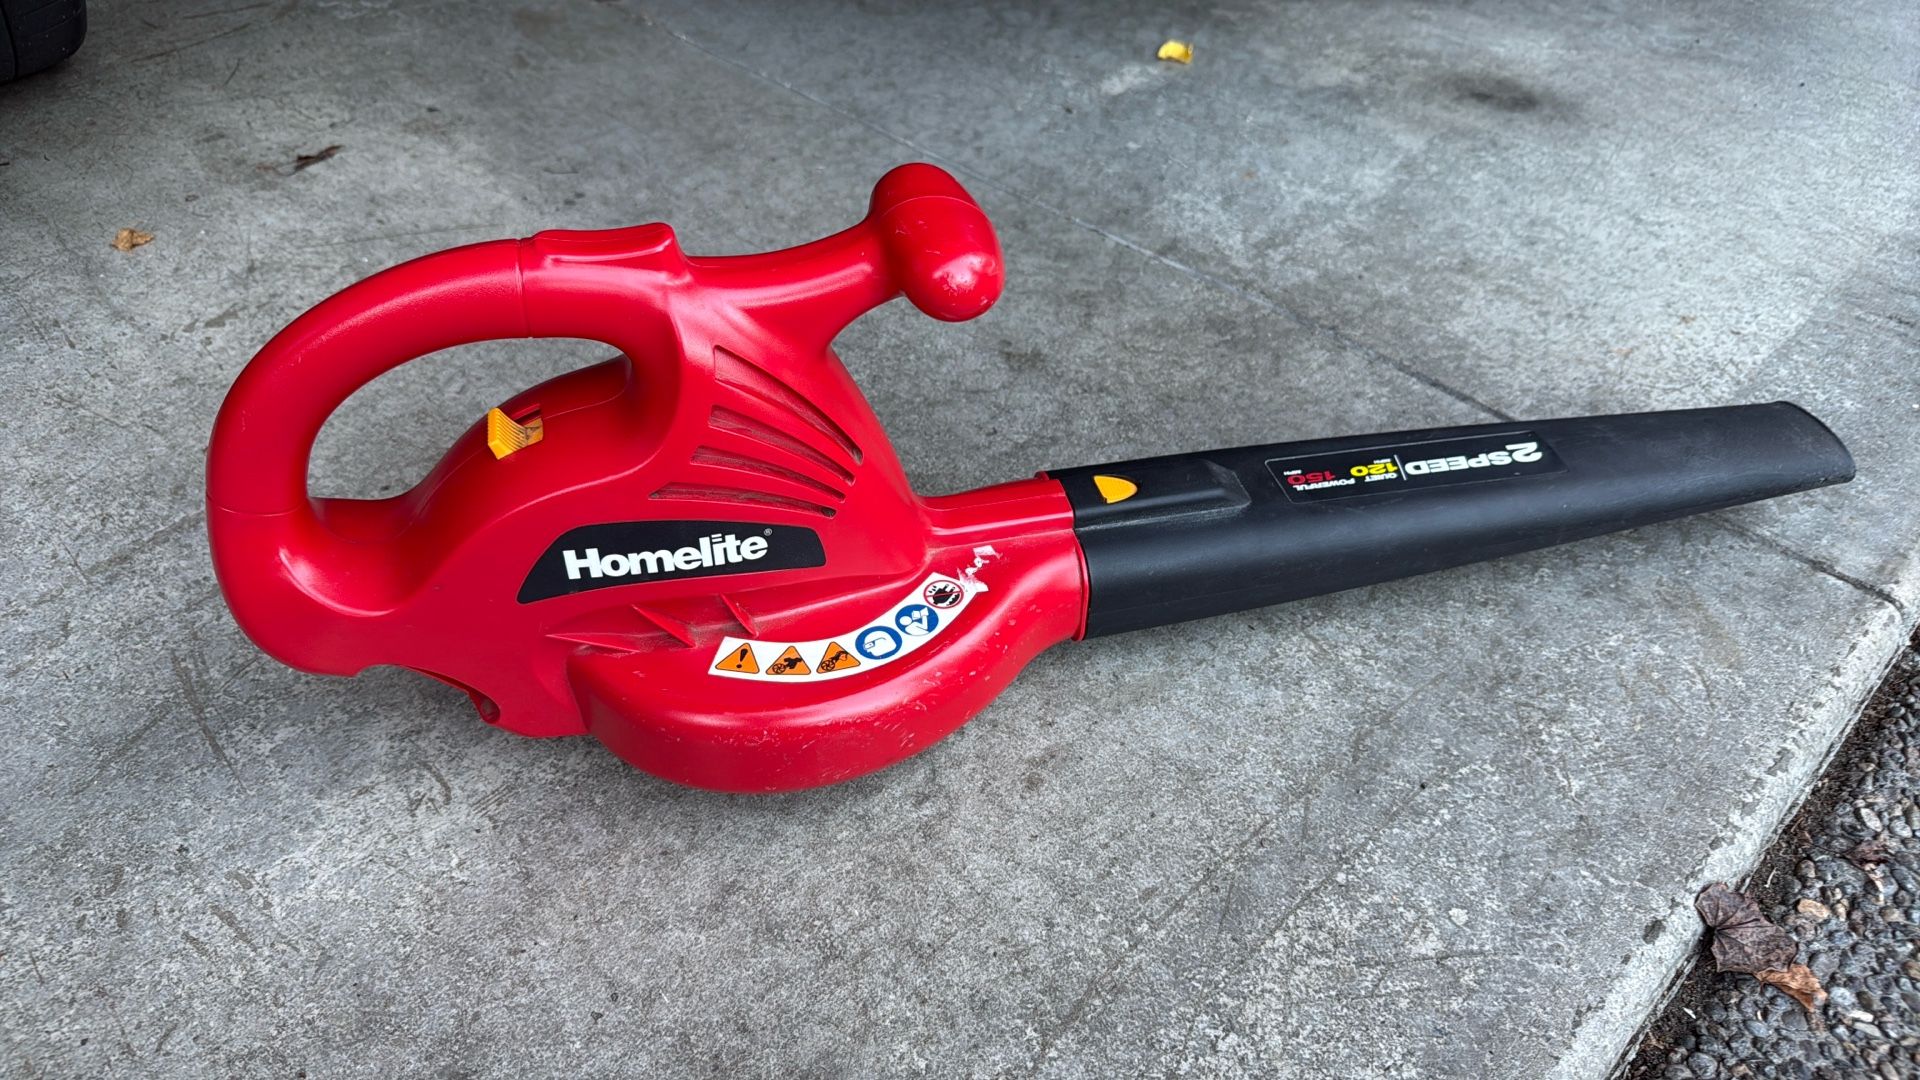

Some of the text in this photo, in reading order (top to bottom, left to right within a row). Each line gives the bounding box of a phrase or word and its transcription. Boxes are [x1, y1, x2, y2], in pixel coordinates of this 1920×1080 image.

[1350, 462, 1398, 477] 120
[1287, 471, 1336, 485] 150
[1364, 472, 1398, 482] QUIET
[1293, 478, 1356, 491] POWERFUL
